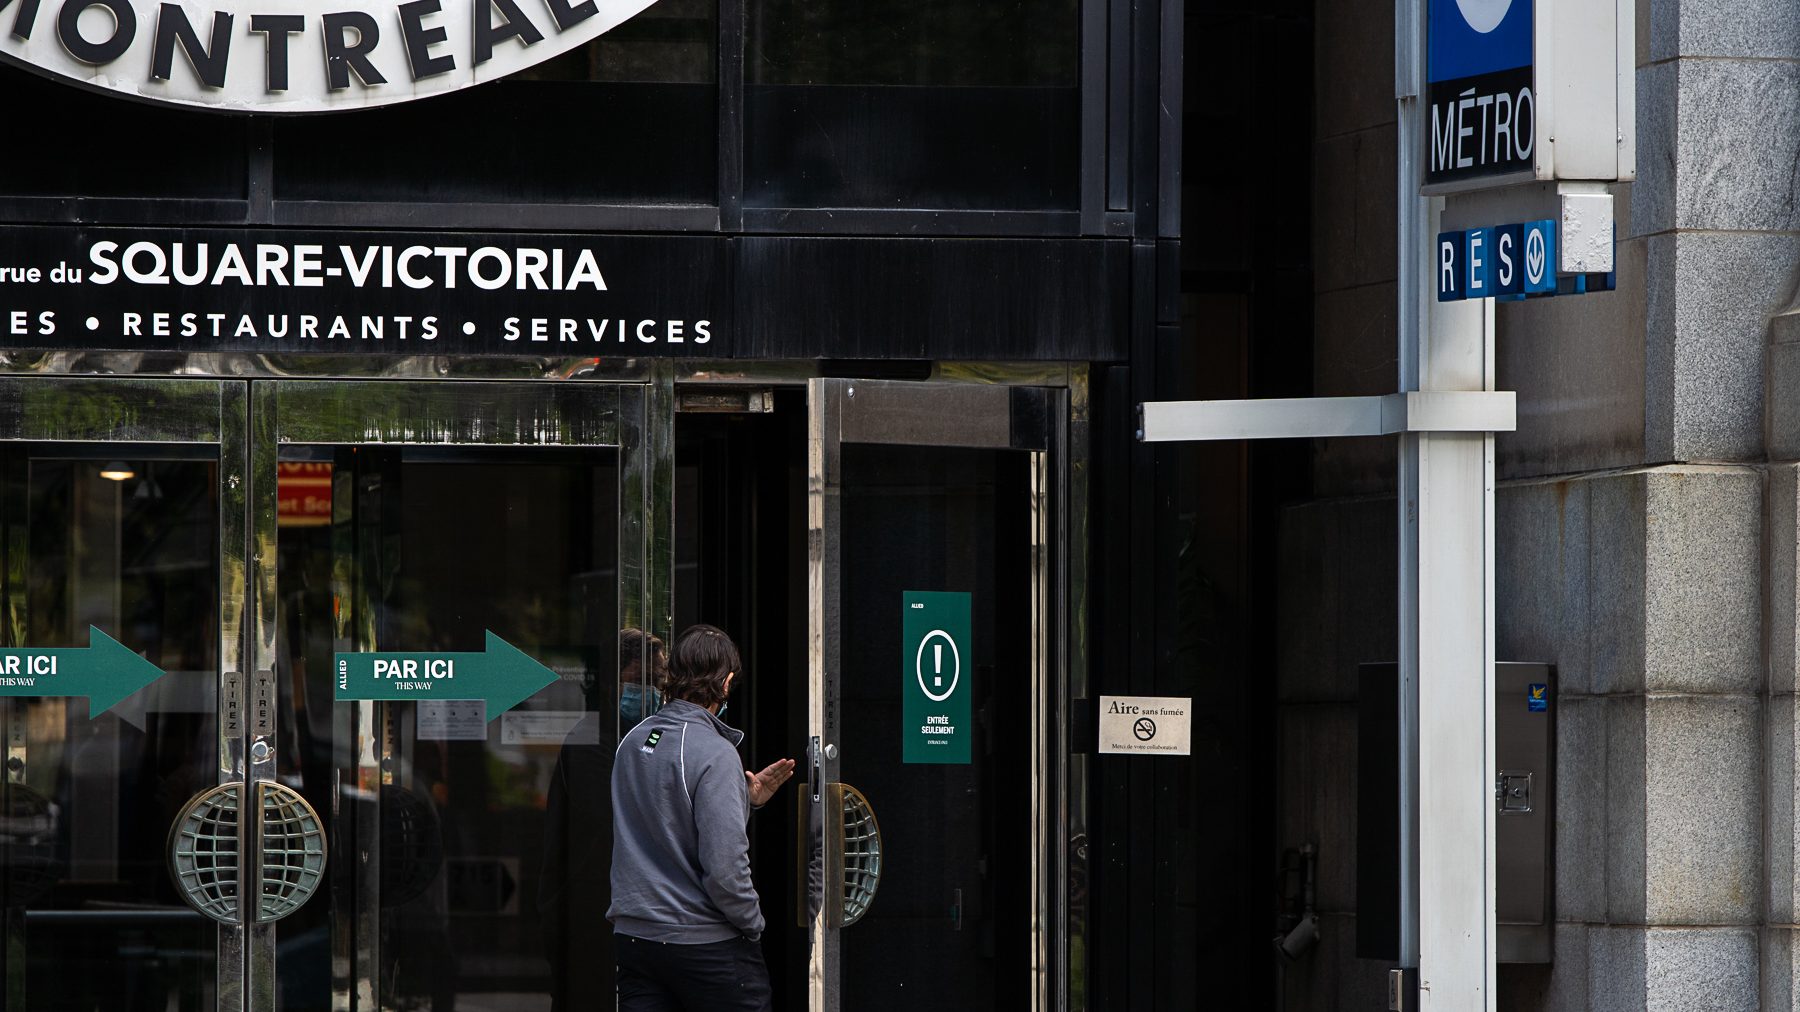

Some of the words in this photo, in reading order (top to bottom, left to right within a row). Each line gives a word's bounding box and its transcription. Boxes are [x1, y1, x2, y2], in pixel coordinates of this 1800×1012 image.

[1431, 86, 1534, 172] MÉTRO
[0, 266, 42, 284] rue
[49, 261, 82, 284] du
[88, 240, 609, 292] SQUARE-VICTORIA
[123, 312, 439, 341] RESTAURANTS
[503, 316, 712, 344] SERVICES
[0, 655, 21, 675] R
[27, 655, 57, 675] ICI
[339, 659, 347, 690] ALLIED
[373, 659, 418, 679] PAR
[424, 659, 454, 679] ICI
[16, 677, 35, 686] WAY
[394, 681, 414, 690] THIS
[414, 681, 433, 690] WAY
[229, 680, 237, 730] TIREZ
[259, 679, 267, 728] TIREZ
[1108, 701, 1139, 715] Aire
[1142, 708, 1159, 716] sans
[1160, 707, 1184, 716] fumée
[927, 714, 949, 725] ENTRÉE
[921, 725, 955, 735] SEULEMENT
